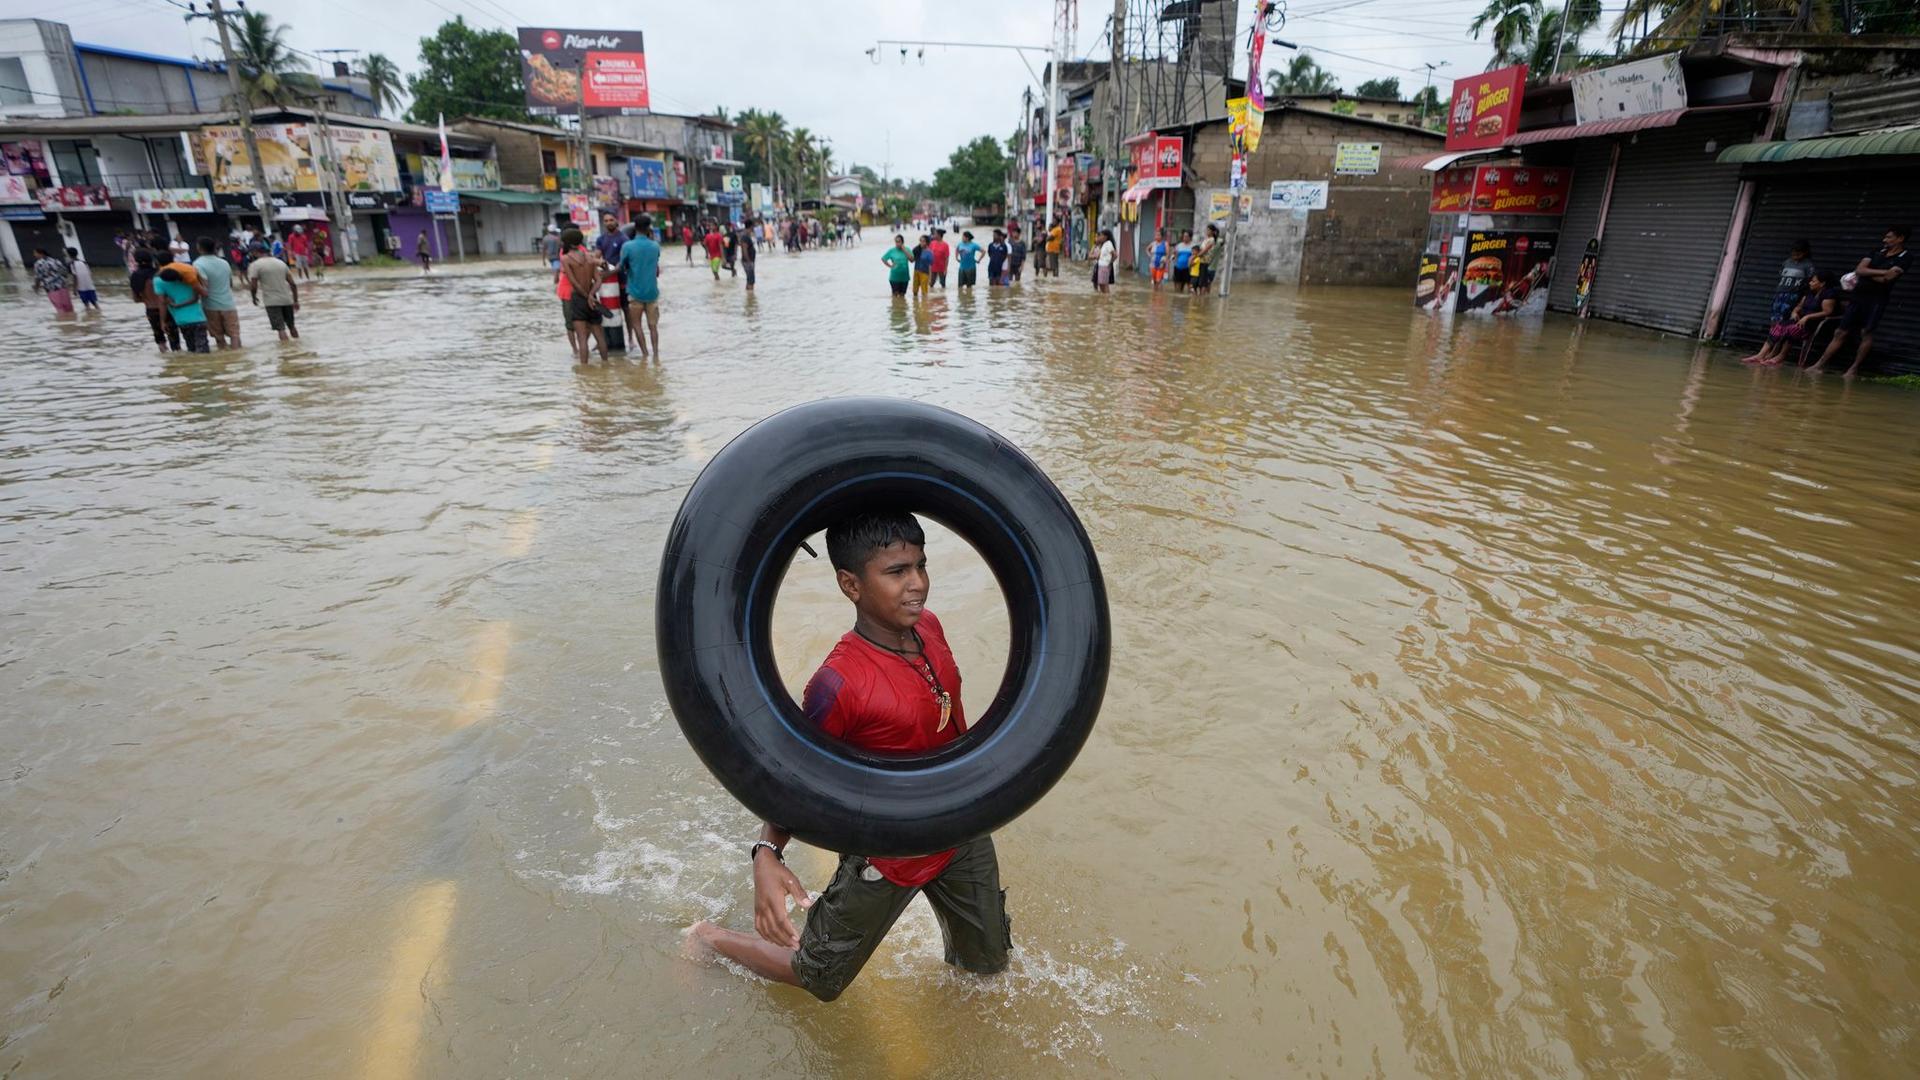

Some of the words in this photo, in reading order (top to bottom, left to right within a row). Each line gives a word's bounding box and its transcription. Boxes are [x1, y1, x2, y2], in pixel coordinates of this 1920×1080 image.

[564, 34, 596, 49] Pizza
[597, 35, 621, 49] Hut
[1618, 73, 1644, 83] Shades
[1479, 82, 1491, 95] MR.
[1476, 87, 1509, 116] BURGER
[1496, 188, 1512, 197] MR.
[1494, 194, 1537, 210] BURGER
[1472, 233, 1486, 242] MR.
[1470, 239, 1507, 253] BURGER
